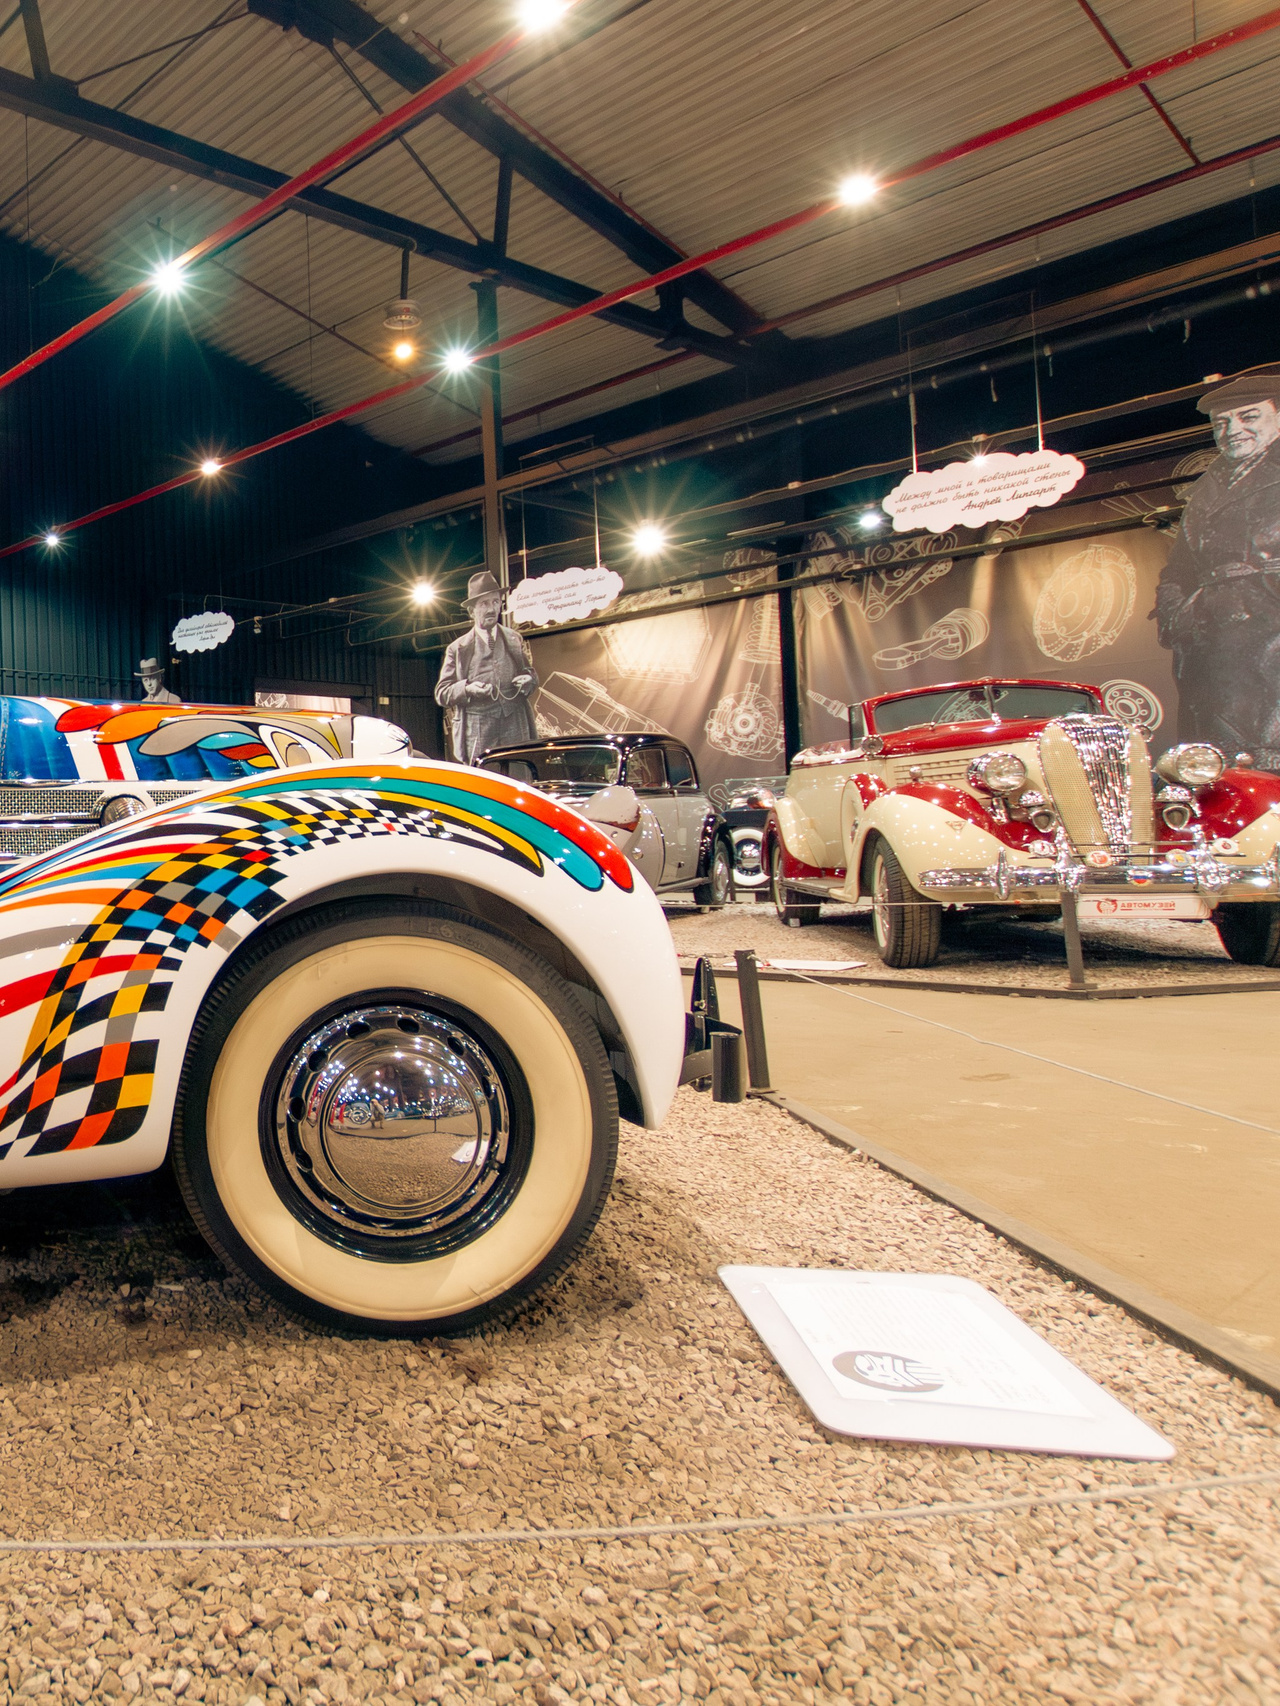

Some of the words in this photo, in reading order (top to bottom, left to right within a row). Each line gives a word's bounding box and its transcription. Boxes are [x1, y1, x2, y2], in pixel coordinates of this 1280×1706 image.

[894, 491, 932, 504] Между
[935, 481, 962, 495] мной
[966, 479, 974, 488] и
[978, 463, 1051, 484] товарищами
[896, 506, 907, 514] не
[910, 496, 948, 513] должно
[952, 488, 980, 501] быть
[983, 478, 1030, 494] никакой
[1034, 469, 1071, 483] стены
[961, 496, 1002, 512] Андрей
[1006, 483, 1057, 503] Липгарт
